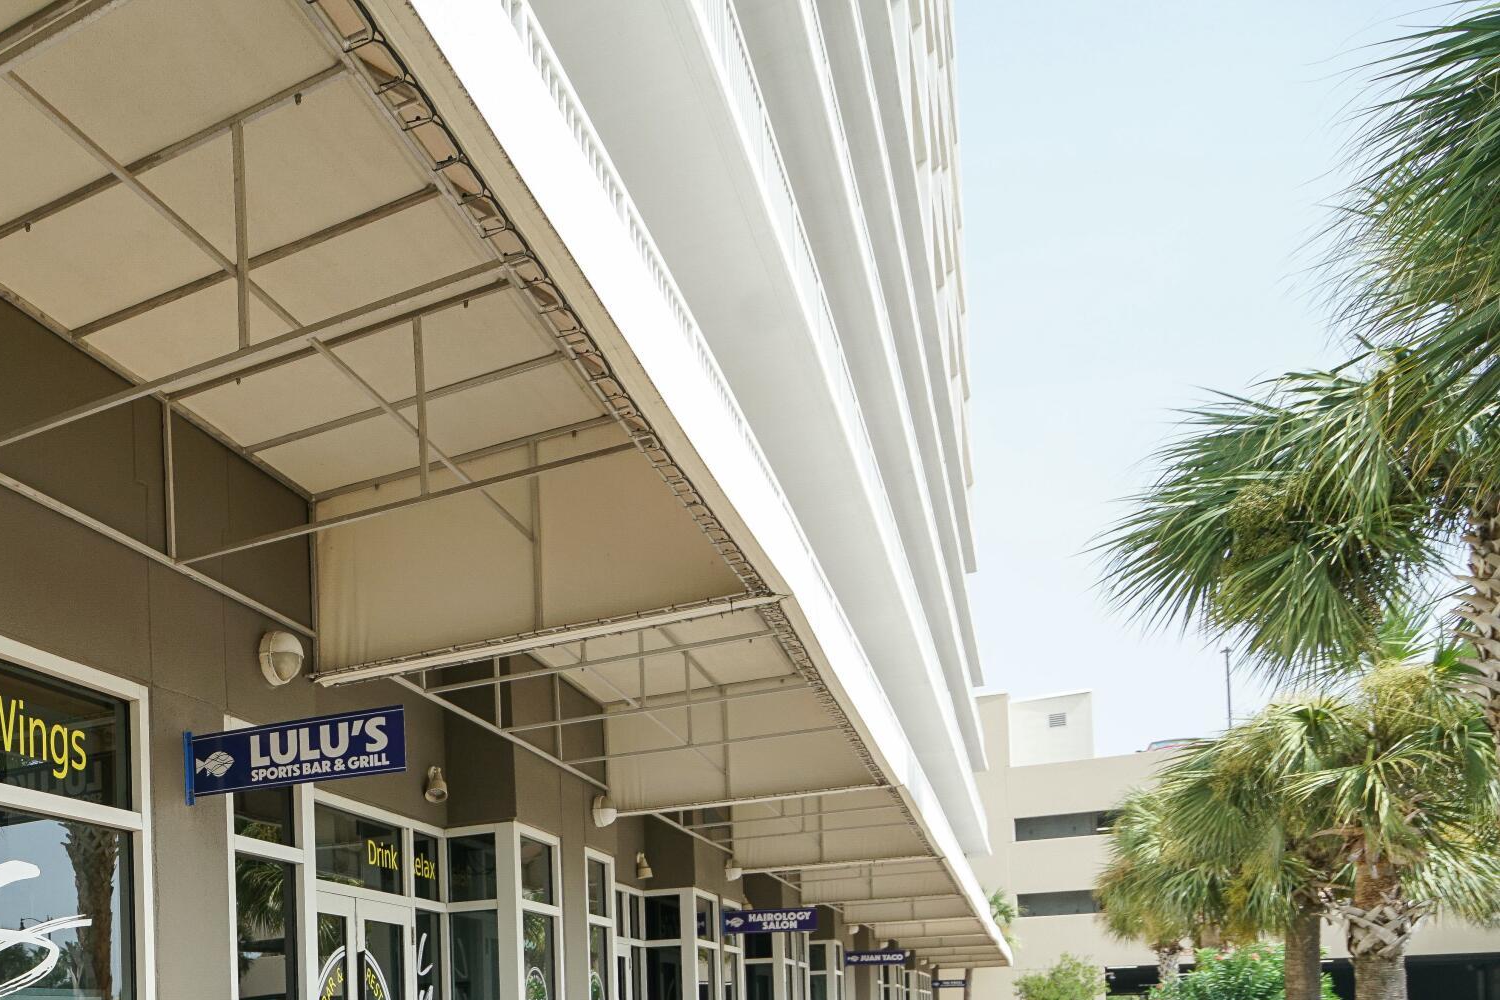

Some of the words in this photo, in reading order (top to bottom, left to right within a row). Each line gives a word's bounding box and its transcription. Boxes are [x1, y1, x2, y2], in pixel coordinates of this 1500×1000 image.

[250, 716, 388, 767] LULU'S
[252, 763, 300, 782] SPORTS
[303, 759, 332, 776] BAR
[333, 758, 346, 772] &
[347, 753, 390, 769] GRILL
[368, 840, 398, 870] Drink
[414, 853, 436, 880] elax
[748, 911, 812, 922] HAIROLOGY
[762, 920, 798, 930] SALON
[336, 967, 344, 983] &
